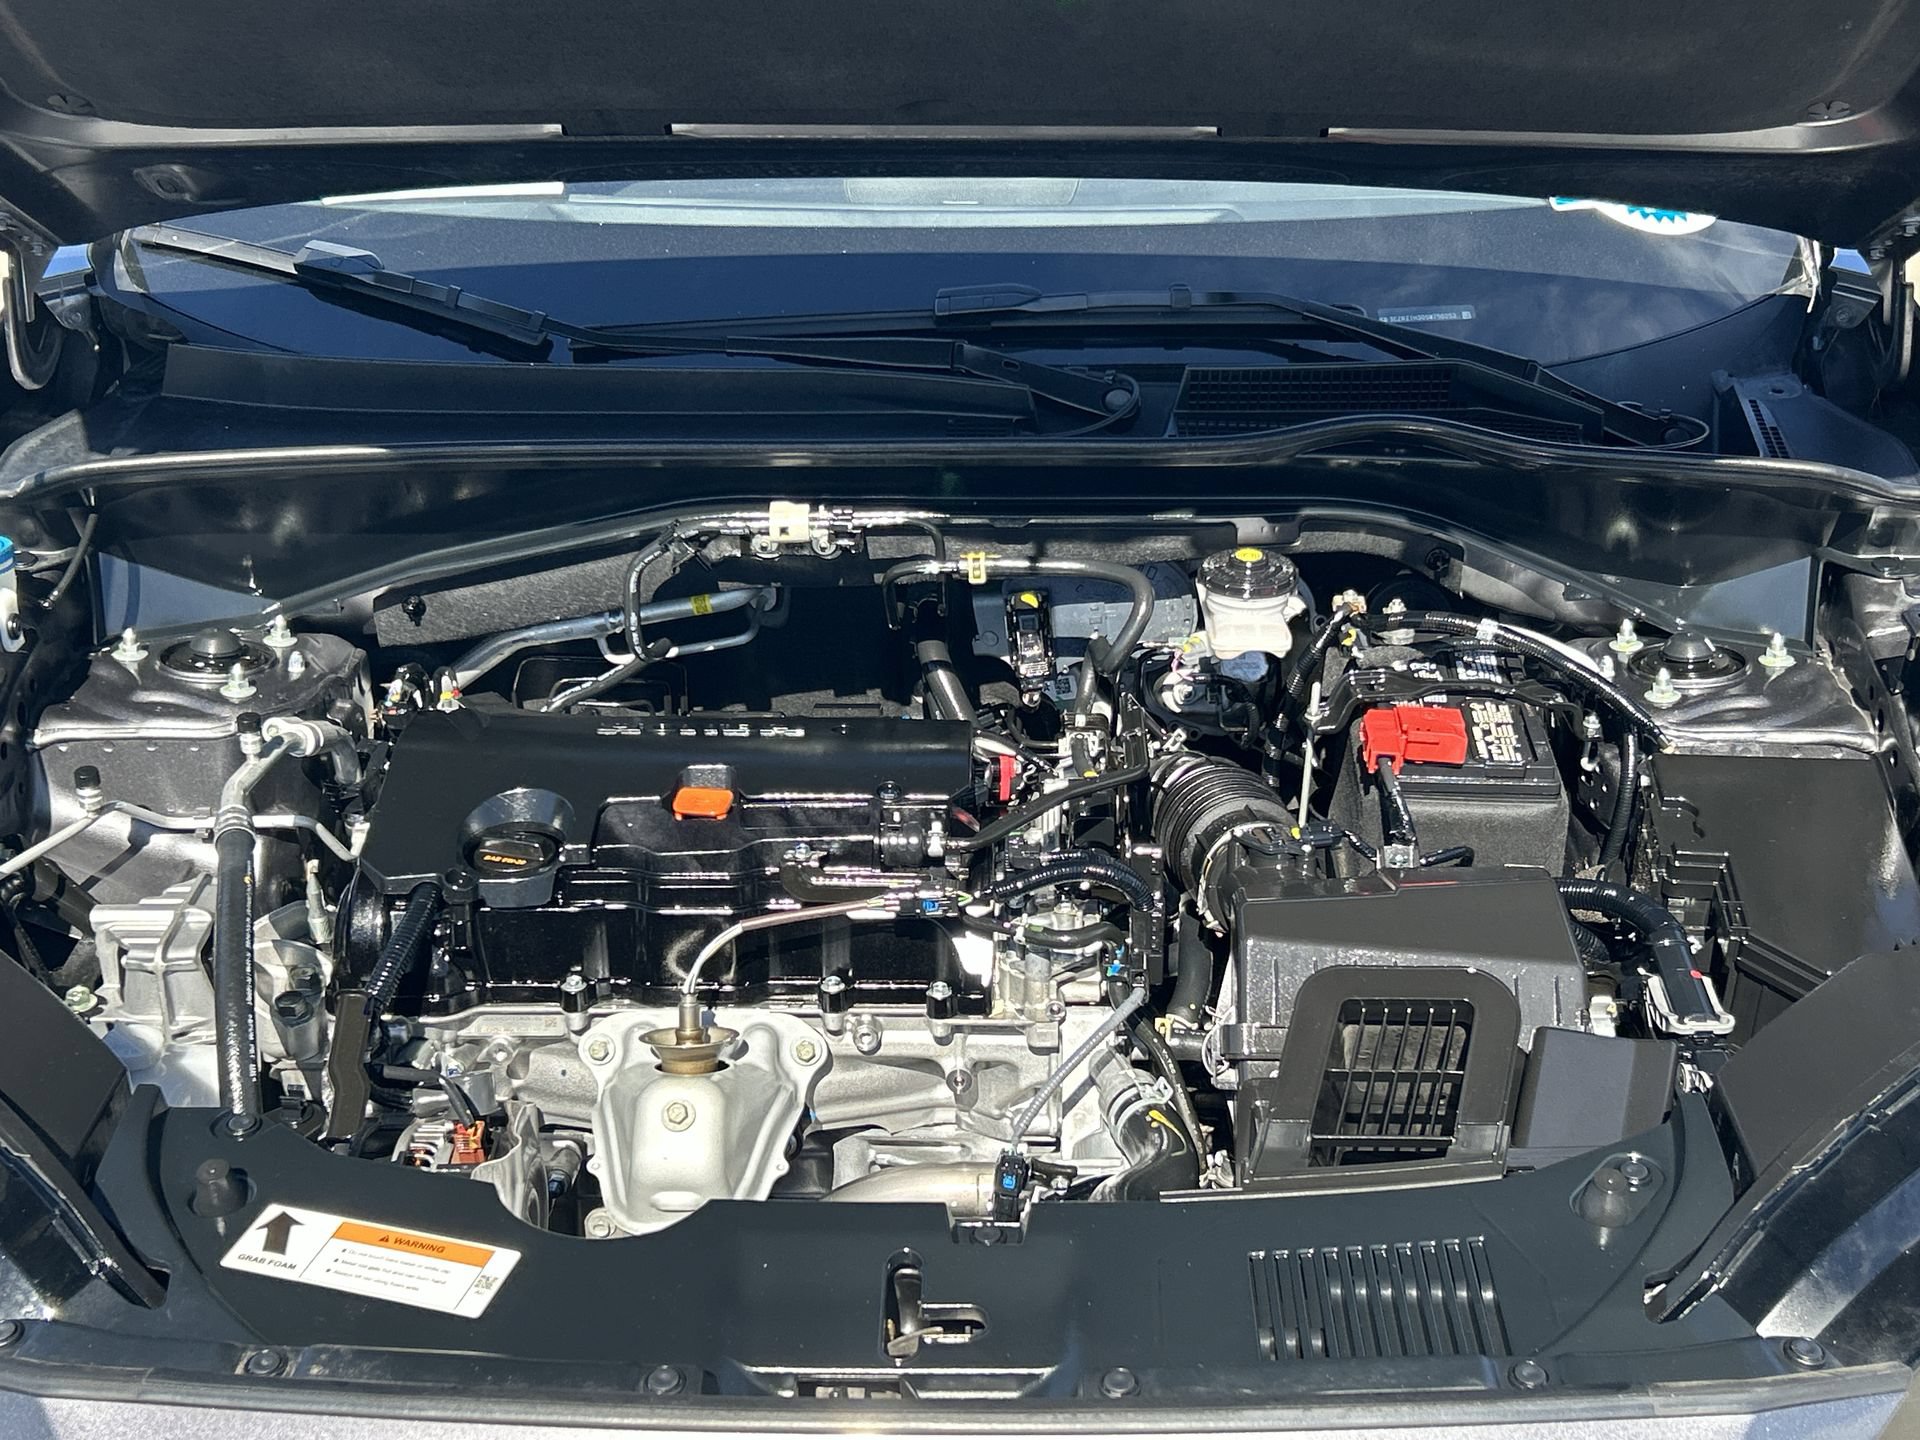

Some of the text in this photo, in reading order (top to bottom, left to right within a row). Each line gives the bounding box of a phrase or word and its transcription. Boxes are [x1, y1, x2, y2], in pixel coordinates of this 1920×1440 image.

[394, 1236, 446, 1253] WARNING
[238, 1253, 297, 1270] GRAB FOAM
